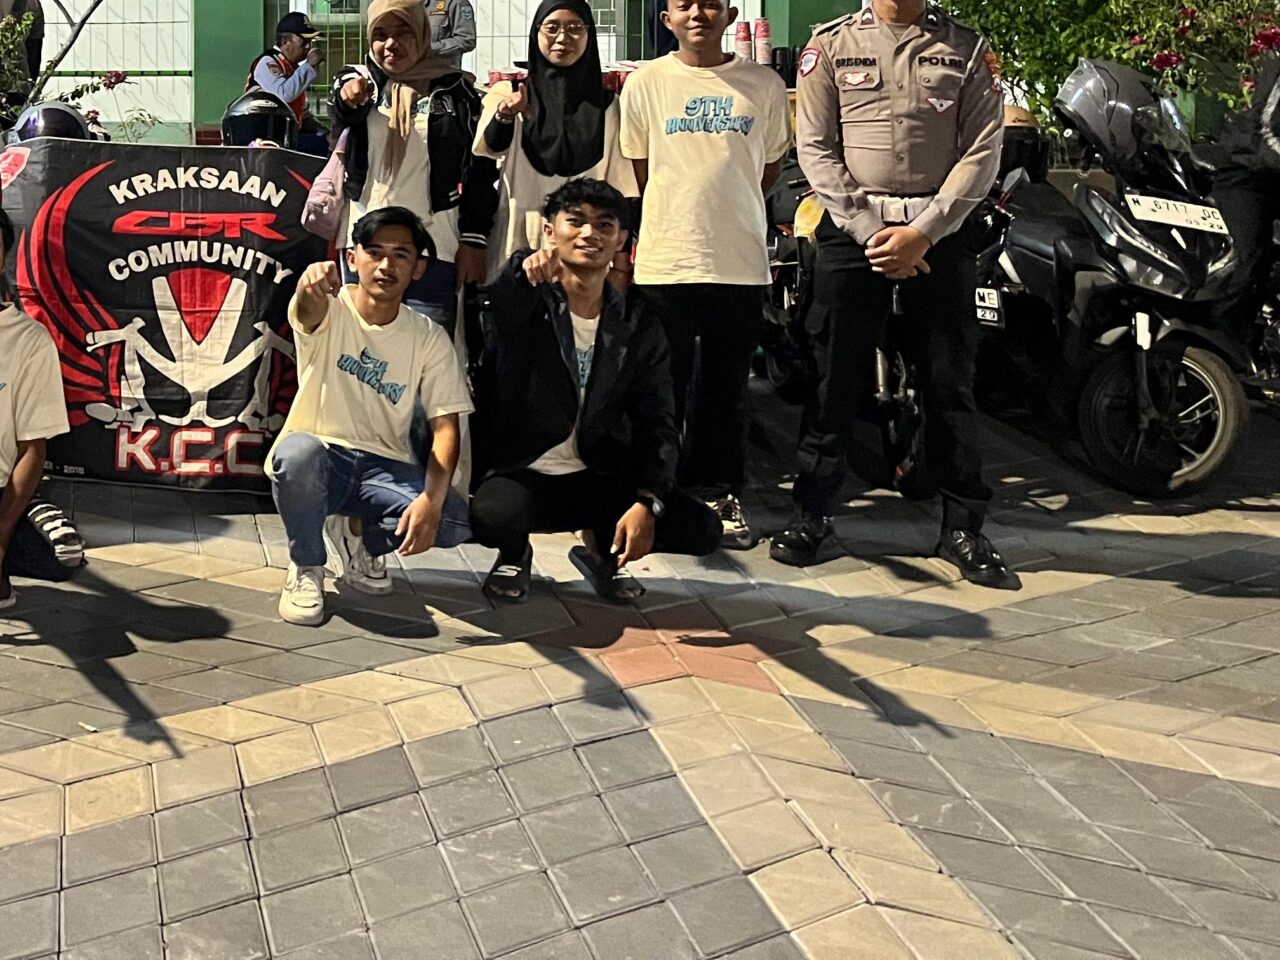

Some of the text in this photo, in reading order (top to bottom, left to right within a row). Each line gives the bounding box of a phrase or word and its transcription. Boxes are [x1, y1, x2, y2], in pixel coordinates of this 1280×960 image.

[918, 56, 963, 67] POLRI
[686, 96, 733, 117] 9TH
[666, 116, 754, 136] ANNIVERSARY
[109, 166, 286, 208] KRAKSAAN
[108, 240, 293, 285] COMMUNITY
